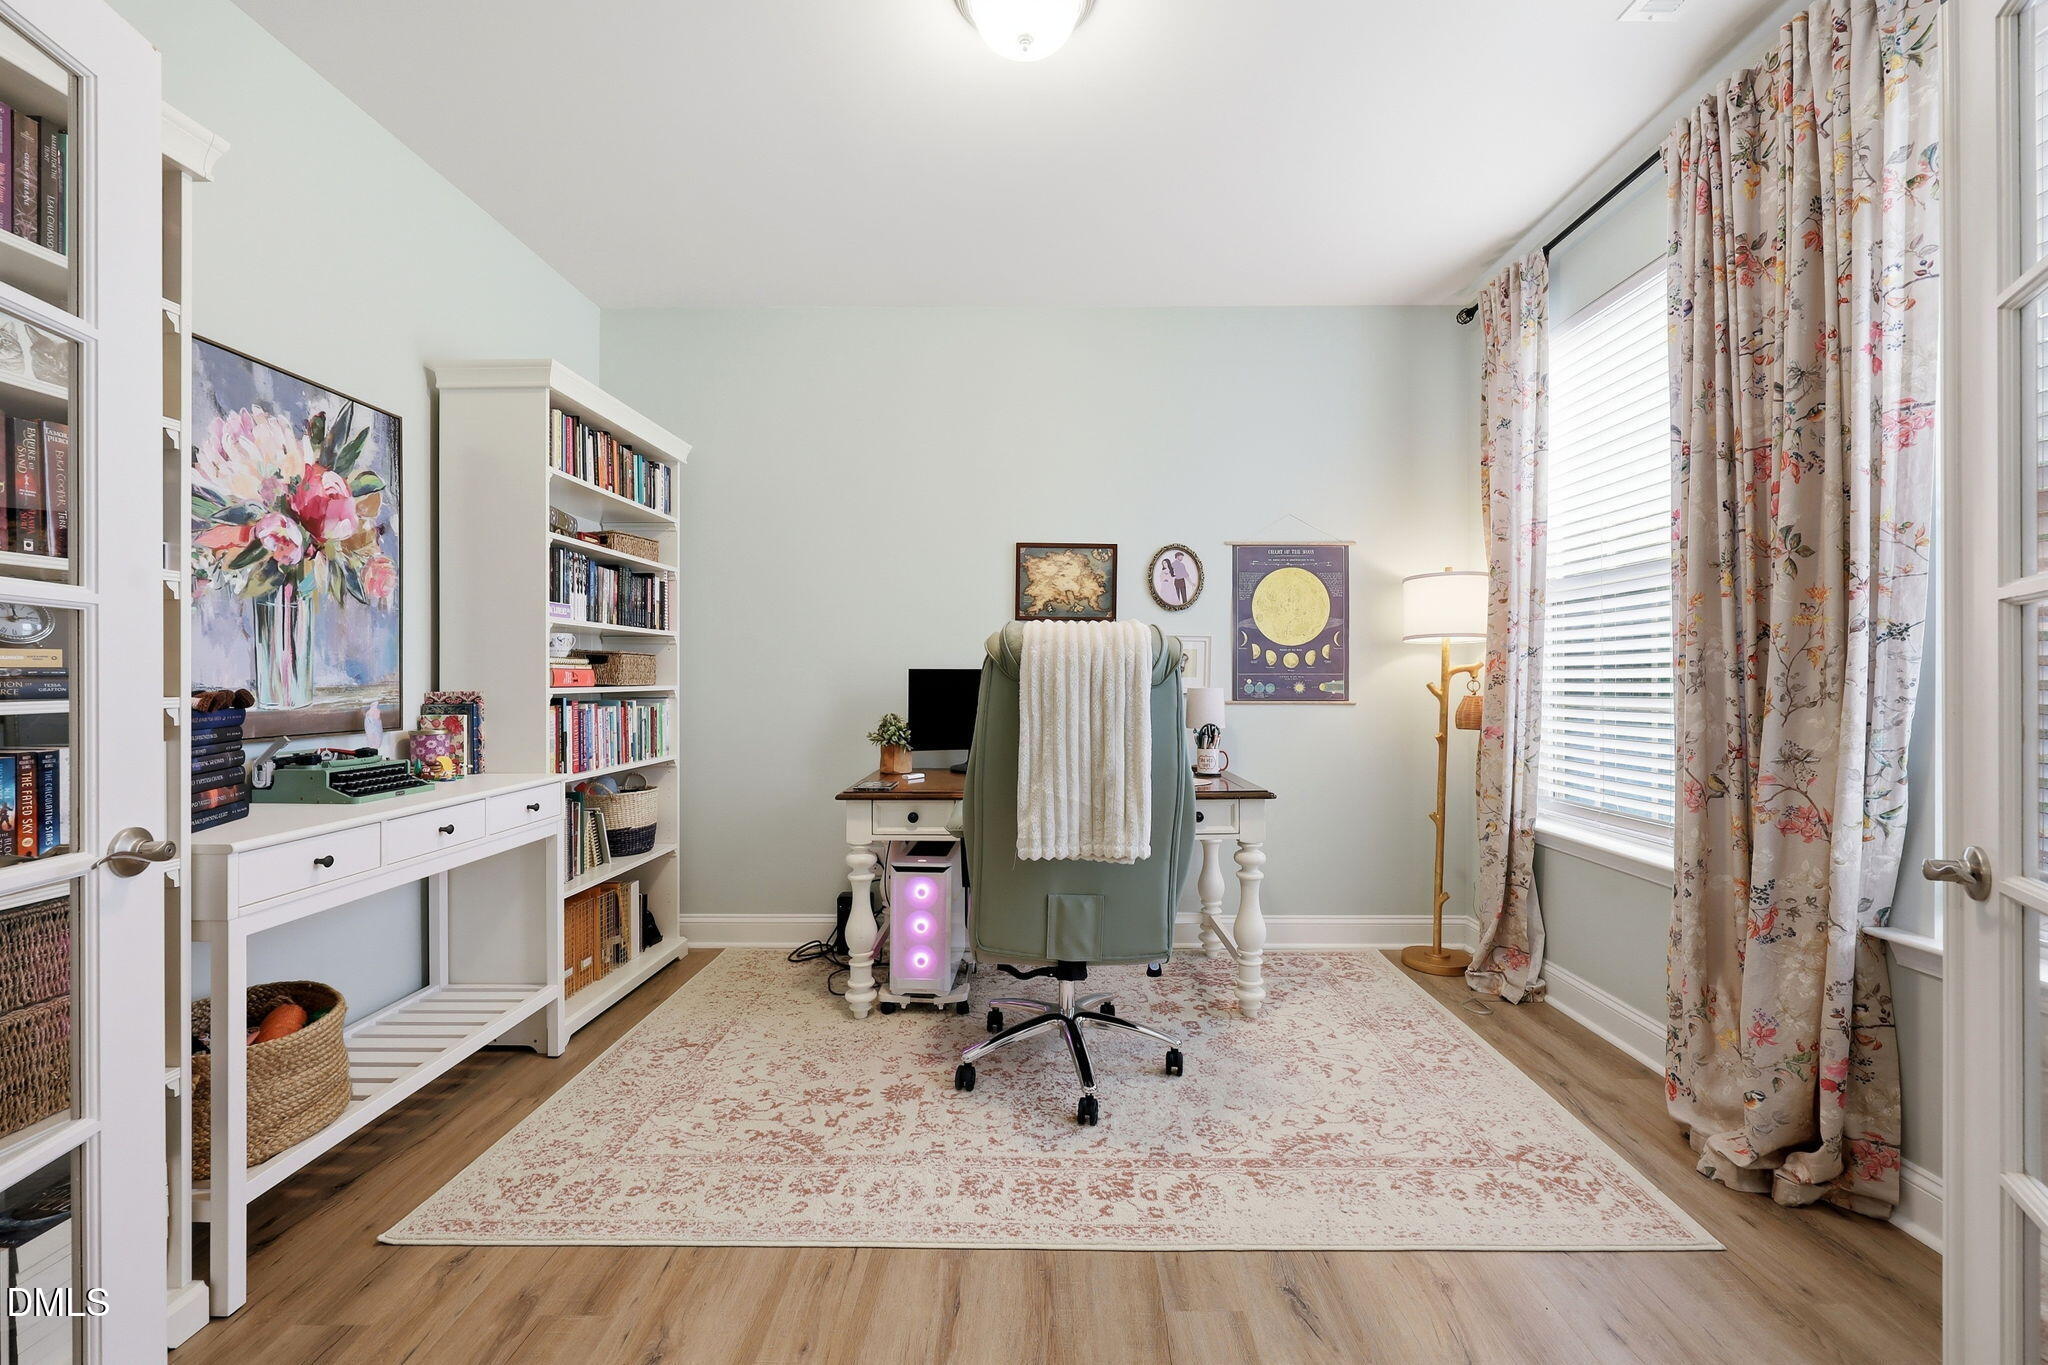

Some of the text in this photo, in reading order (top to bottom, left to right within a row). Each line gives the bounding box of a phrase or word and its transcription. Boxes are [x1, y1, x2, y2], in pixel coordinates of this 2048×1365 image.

[46, 195, 56, 249] LEAH CHIASSO
[23, 427, 36, 461] EMPIRE
[16, 445, 27, 474] SAND
[22, 771, 33, 787] THE
[44, 769, 53, 782] THE
[22, 790, 33, 816] FATED
[44, 782, 54, 825] CALCULATING
[22, 818, 33, 834] SKY
[45, 825, 54, 846] STARS
